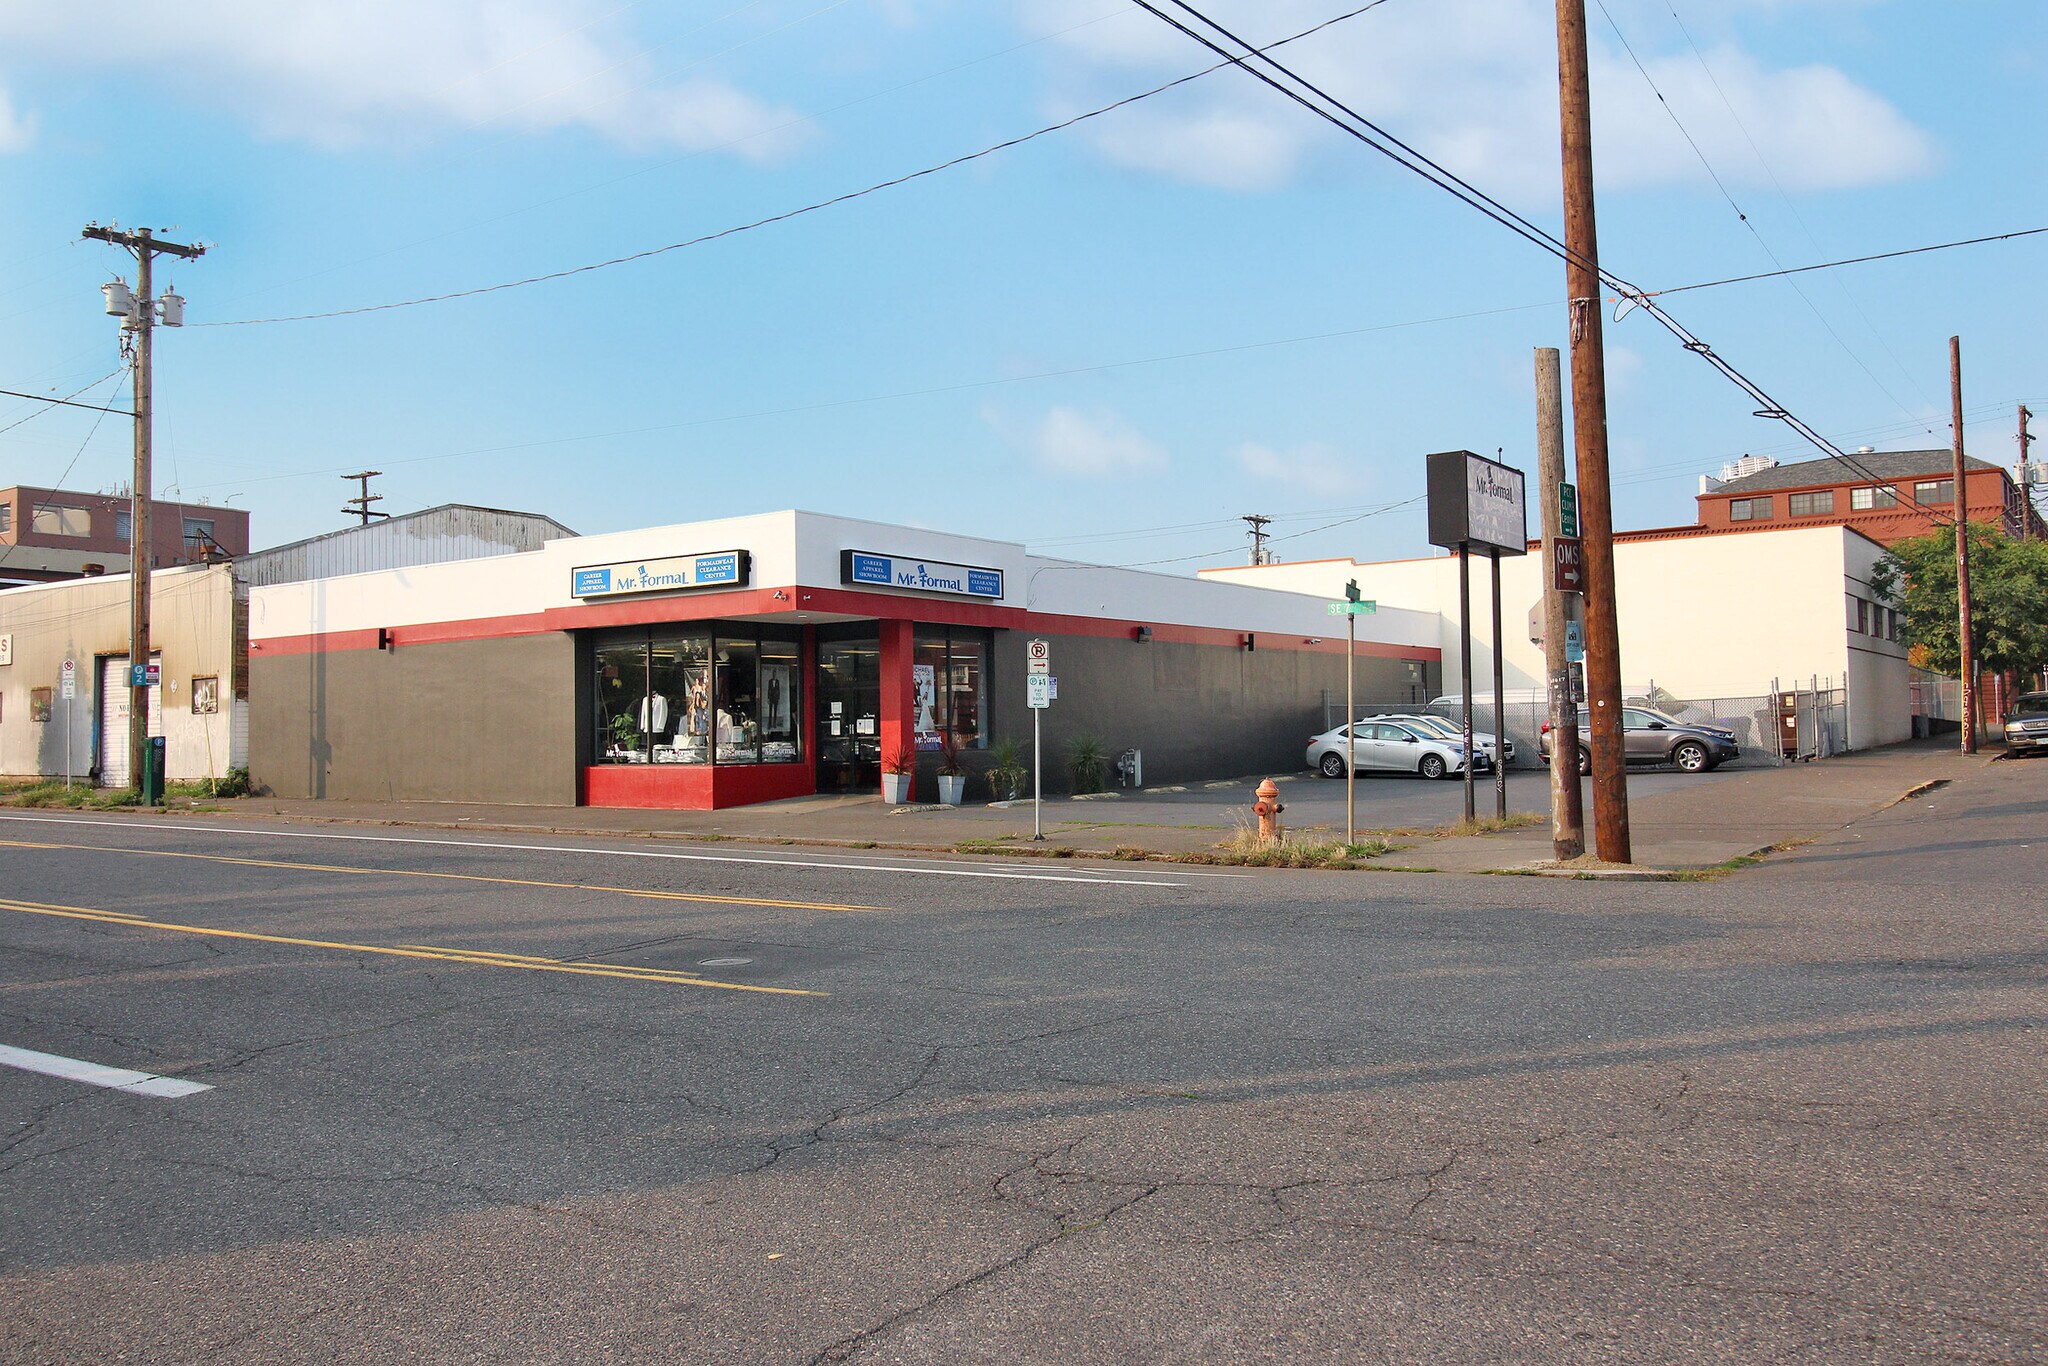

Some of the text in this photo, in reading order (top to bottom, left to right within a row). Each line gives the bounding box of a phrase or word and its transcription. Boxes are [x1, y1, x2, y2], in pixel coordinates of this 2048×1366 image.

[696, 558, 735, 567] FORMALWEAR
[862, 559, 883, 567] CAREER
[699, 565, 732, 573] CLEARANCE
[583, 572, 603, 580] CAREER
[616, 568, 689, 591] Mr. Formal
[858, 571, 888, 580] SHOWROOM
[969, 573, 999, 581] FORMALWEAR
[582, 578, 604, 586] APPAREL
[897, 570, 964, 592] Mr. Formal
[971, 579, 997, 587] CLEARANCE
[1330, 603, 1342, 614] SE
[136, 674, 143, 683] 2
